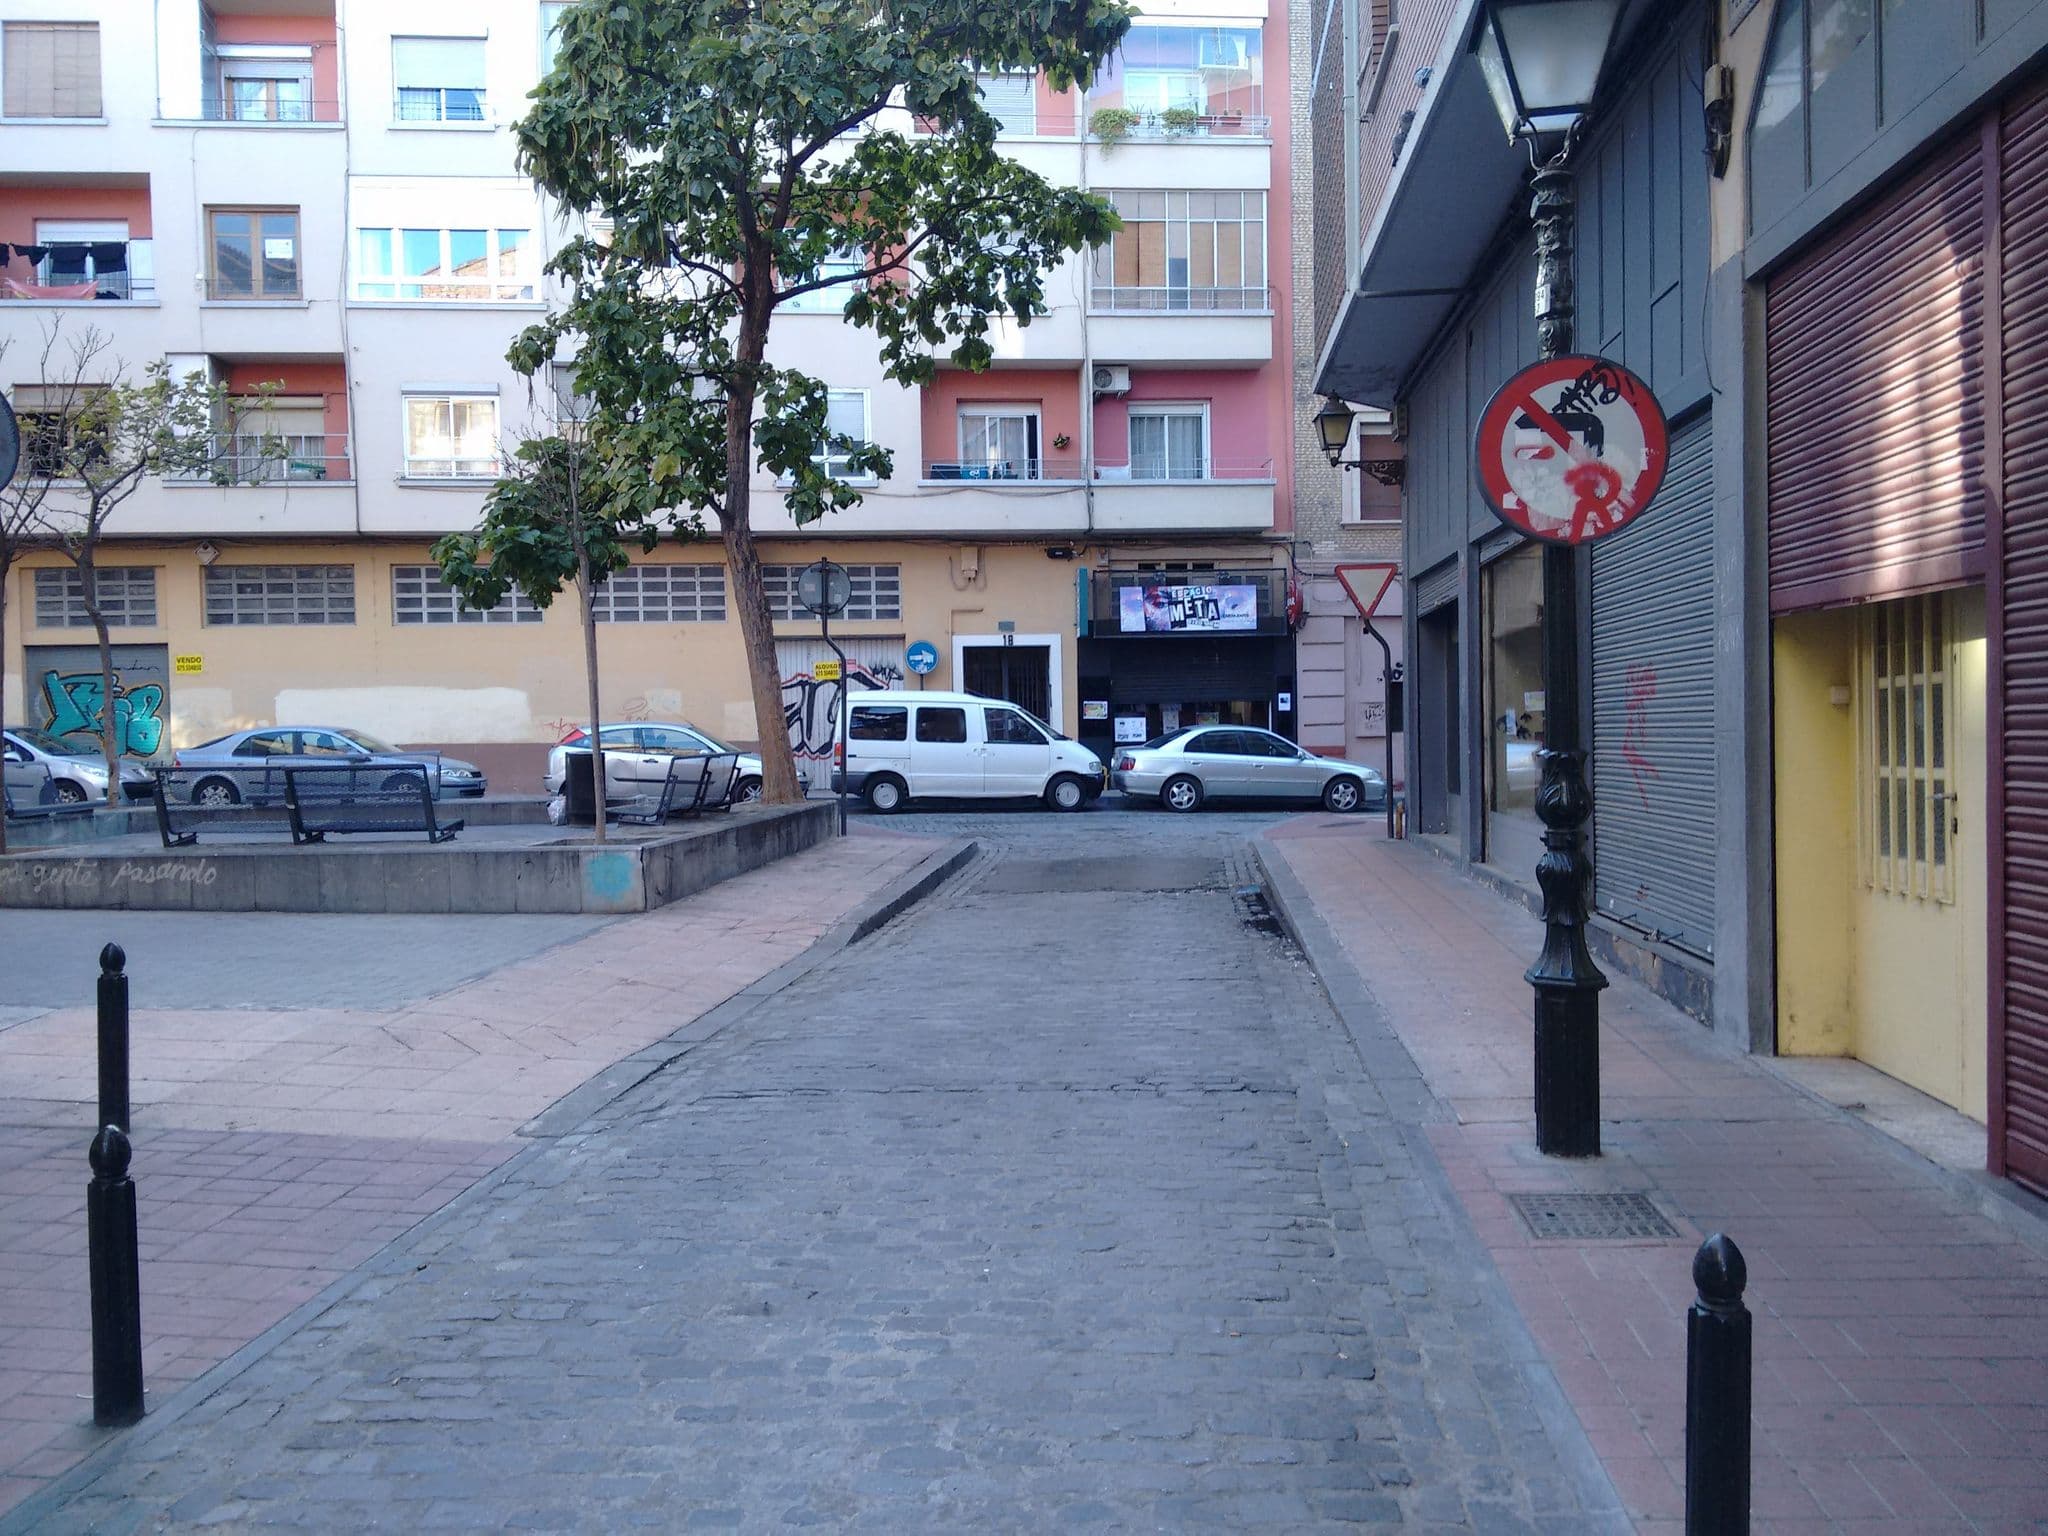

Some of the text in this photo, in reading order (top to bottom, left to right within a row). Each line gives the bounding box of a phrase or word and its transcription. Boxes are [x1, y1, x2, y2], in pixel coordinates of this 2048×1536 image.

[1171, 586, 1213, 599] ESPACIO
[1170, 597, 1219, 622] META
[1003, 634, 1014, 648] 18
[176, 656, 202, 664] VENDO
[33, 858, 97, 893] gente
[109, 858, 217, 888] pasando
